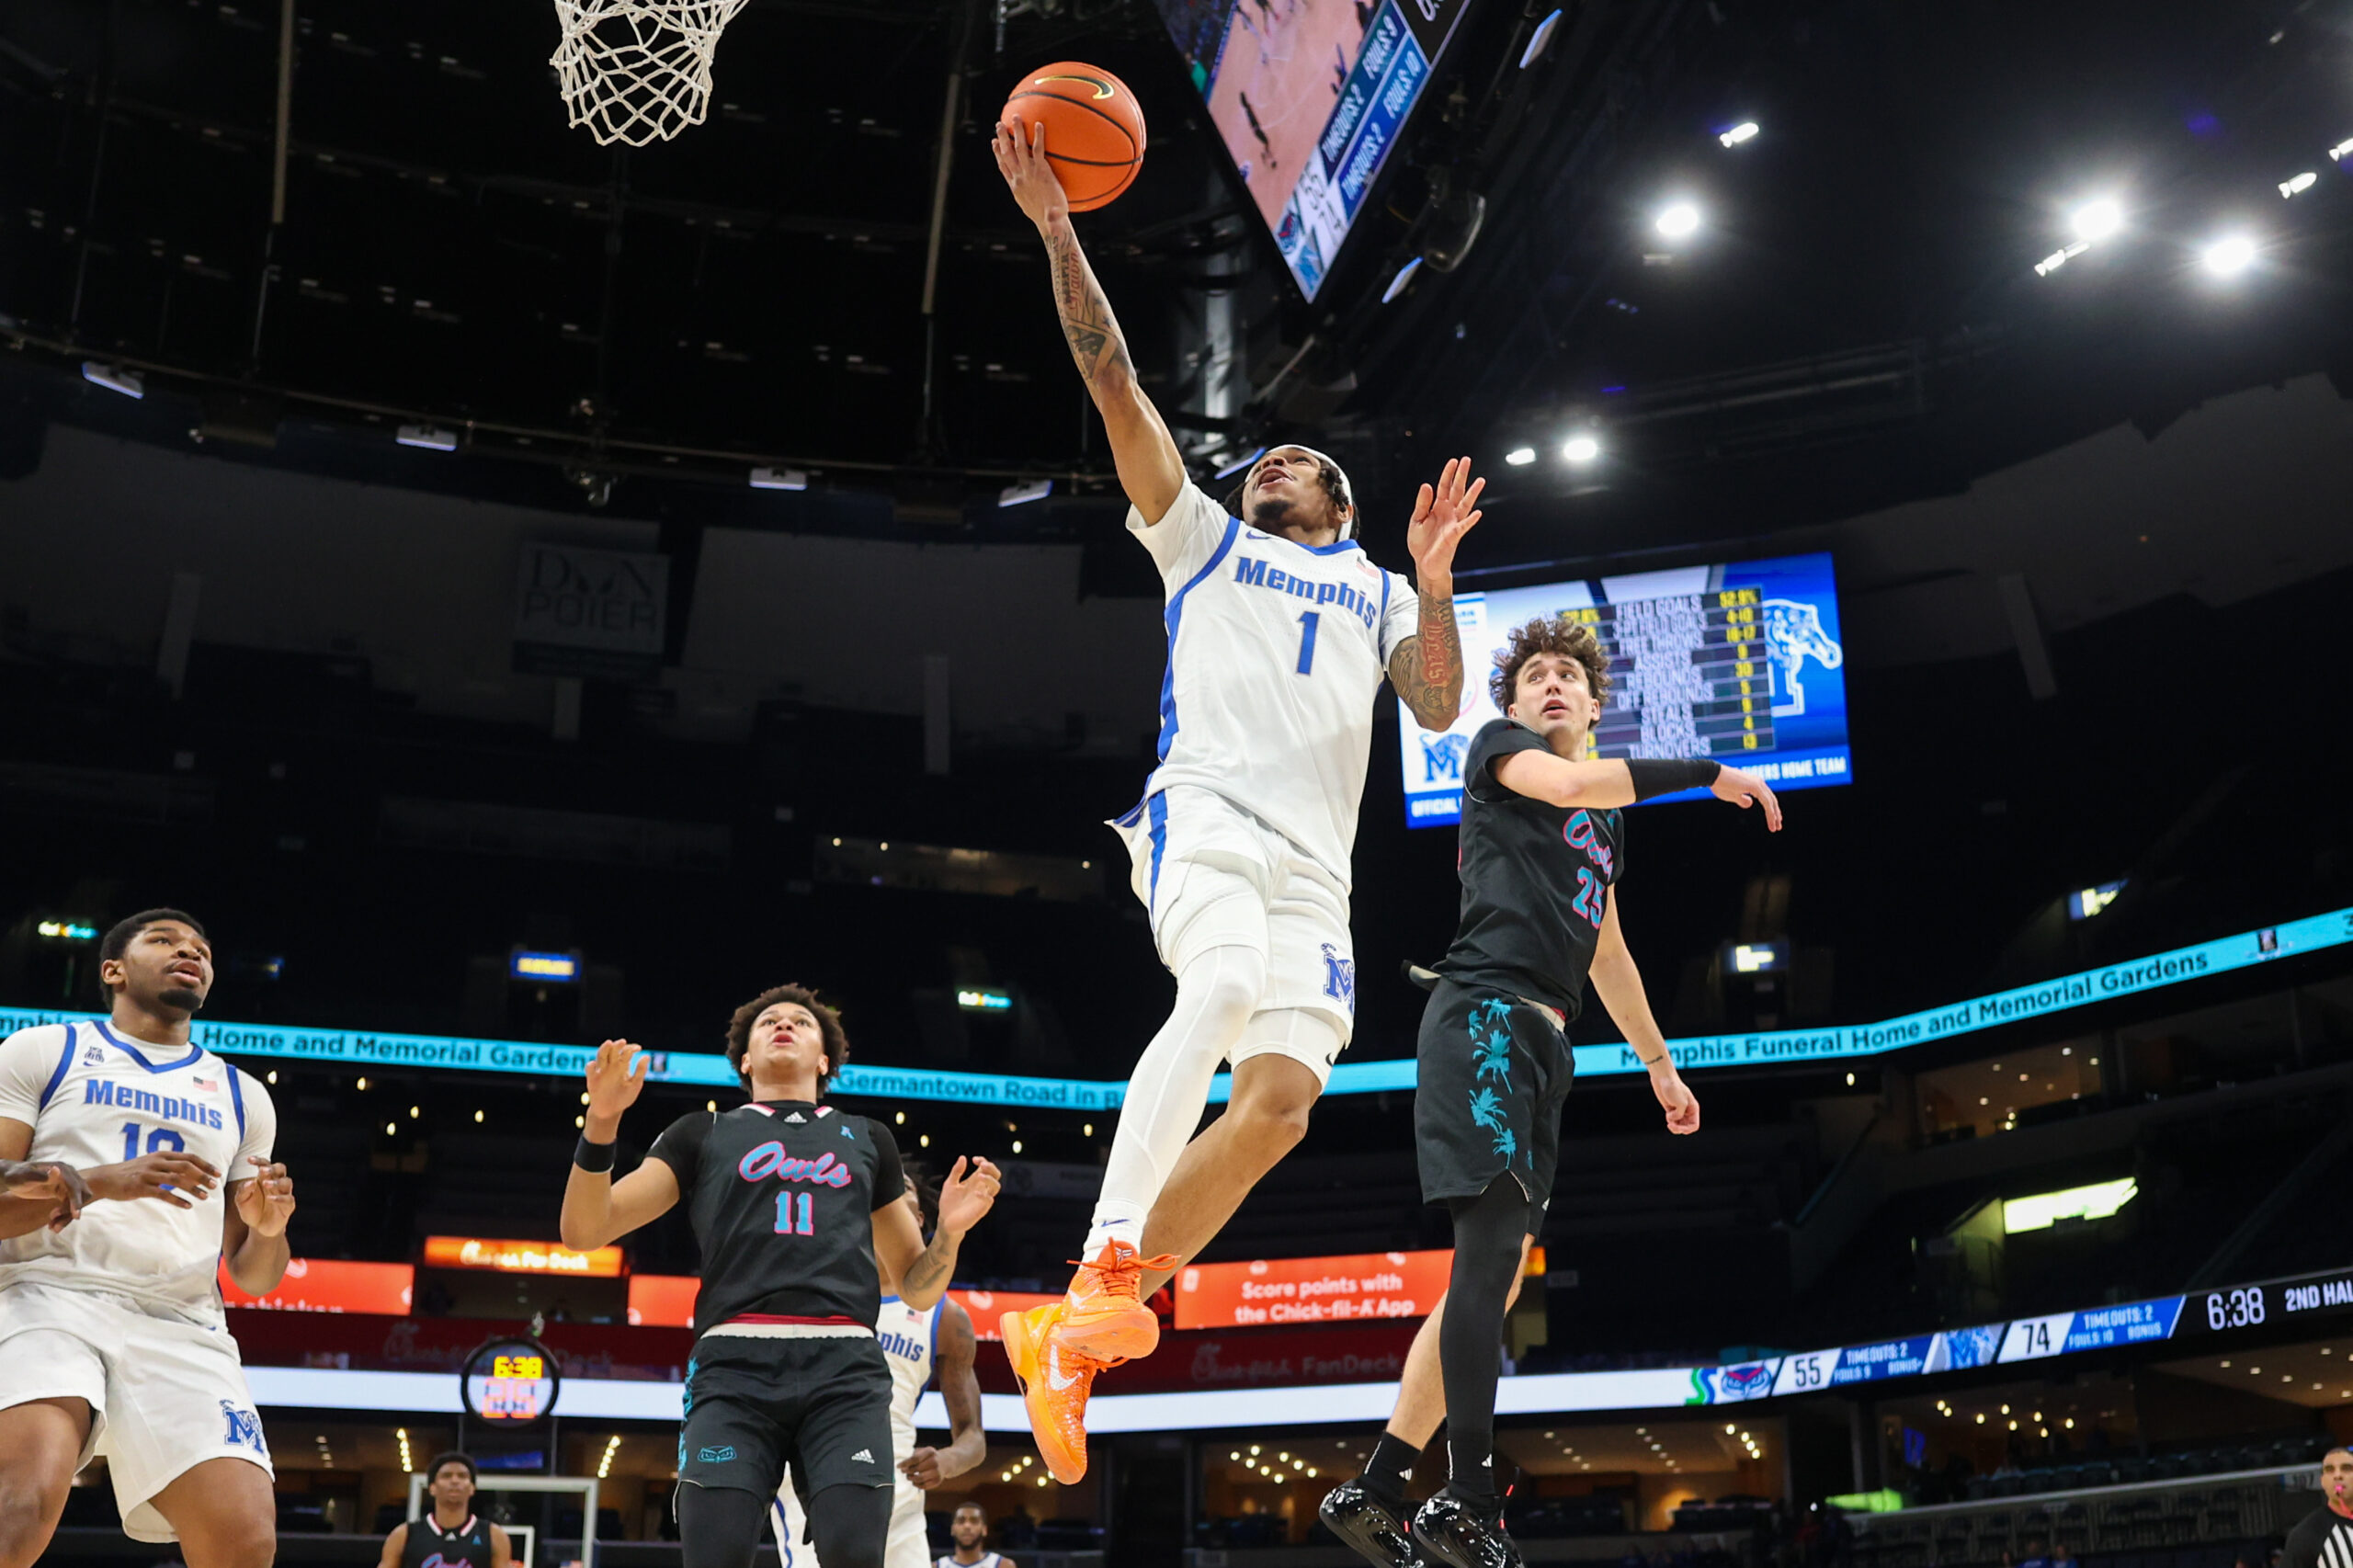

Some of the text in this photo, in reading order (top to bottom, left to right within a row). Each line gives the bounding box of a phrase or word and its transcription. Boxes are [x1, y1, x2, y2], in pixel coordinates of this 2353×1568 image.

[1233, 555, 1377, 631] Memphis
[1615, 598, 1654, 620] FIELD
[1655, 593, 1702, 617] GOALS
[1295, 610, 1320, 677] 1
[1633, 648, 1692, 670] ASSISTS
[1625, 665, 1703, 689] REBOUNDS
[1643, 682, 1715, 706] REBOUNDS
[1641, 702, 1693, 724] STEALS
[1640, 721, 1697, 744] BLOCKS
[1628, 735, 1712, 760] TURNOVERS
[1814, 756, 1847, 776] TEAM
[1745, 1032, 1842, 1057] Funeral
[1852, 1021, 1921, 1049] Home
[1928, 1007, 1972, 1035] and
[1979, 977, 2093, 1022] Memorial
[2099, 951, 2209, 991] Gardens
[202, 1026, 284, 1053] Home
[293, 1030, 345, 1056] and
[355, 1036, 481, 1065] Memorial
[835, 1069, 996, 1099] Germantown
[1006, 1080, 1067, 1104] Road
[84, 1078, 223, 1131] Memphis
[738, 1140, 853, 1188] Owls
[773, 1190, 814, 1236] 11
[1241, 1273, 1404, 1301] Score points with
[2284, 1285, 2321, 1313] 2ND
[1234, 1297, 1415, 1323] the Chick-fil-A App
[2144, 1304, 2153, 1322] 2
[2206, 1287, 2266, 1331] 6:38
[2021, 1322, 2050, 1355] 74
[2127, 1321, 2162, 1340] BONUS
[1900, 1341, 1909, 1358] 2
[494, 1355, 544, 1380] 6:38
[1794, 1356, 1822, 1388] 55
